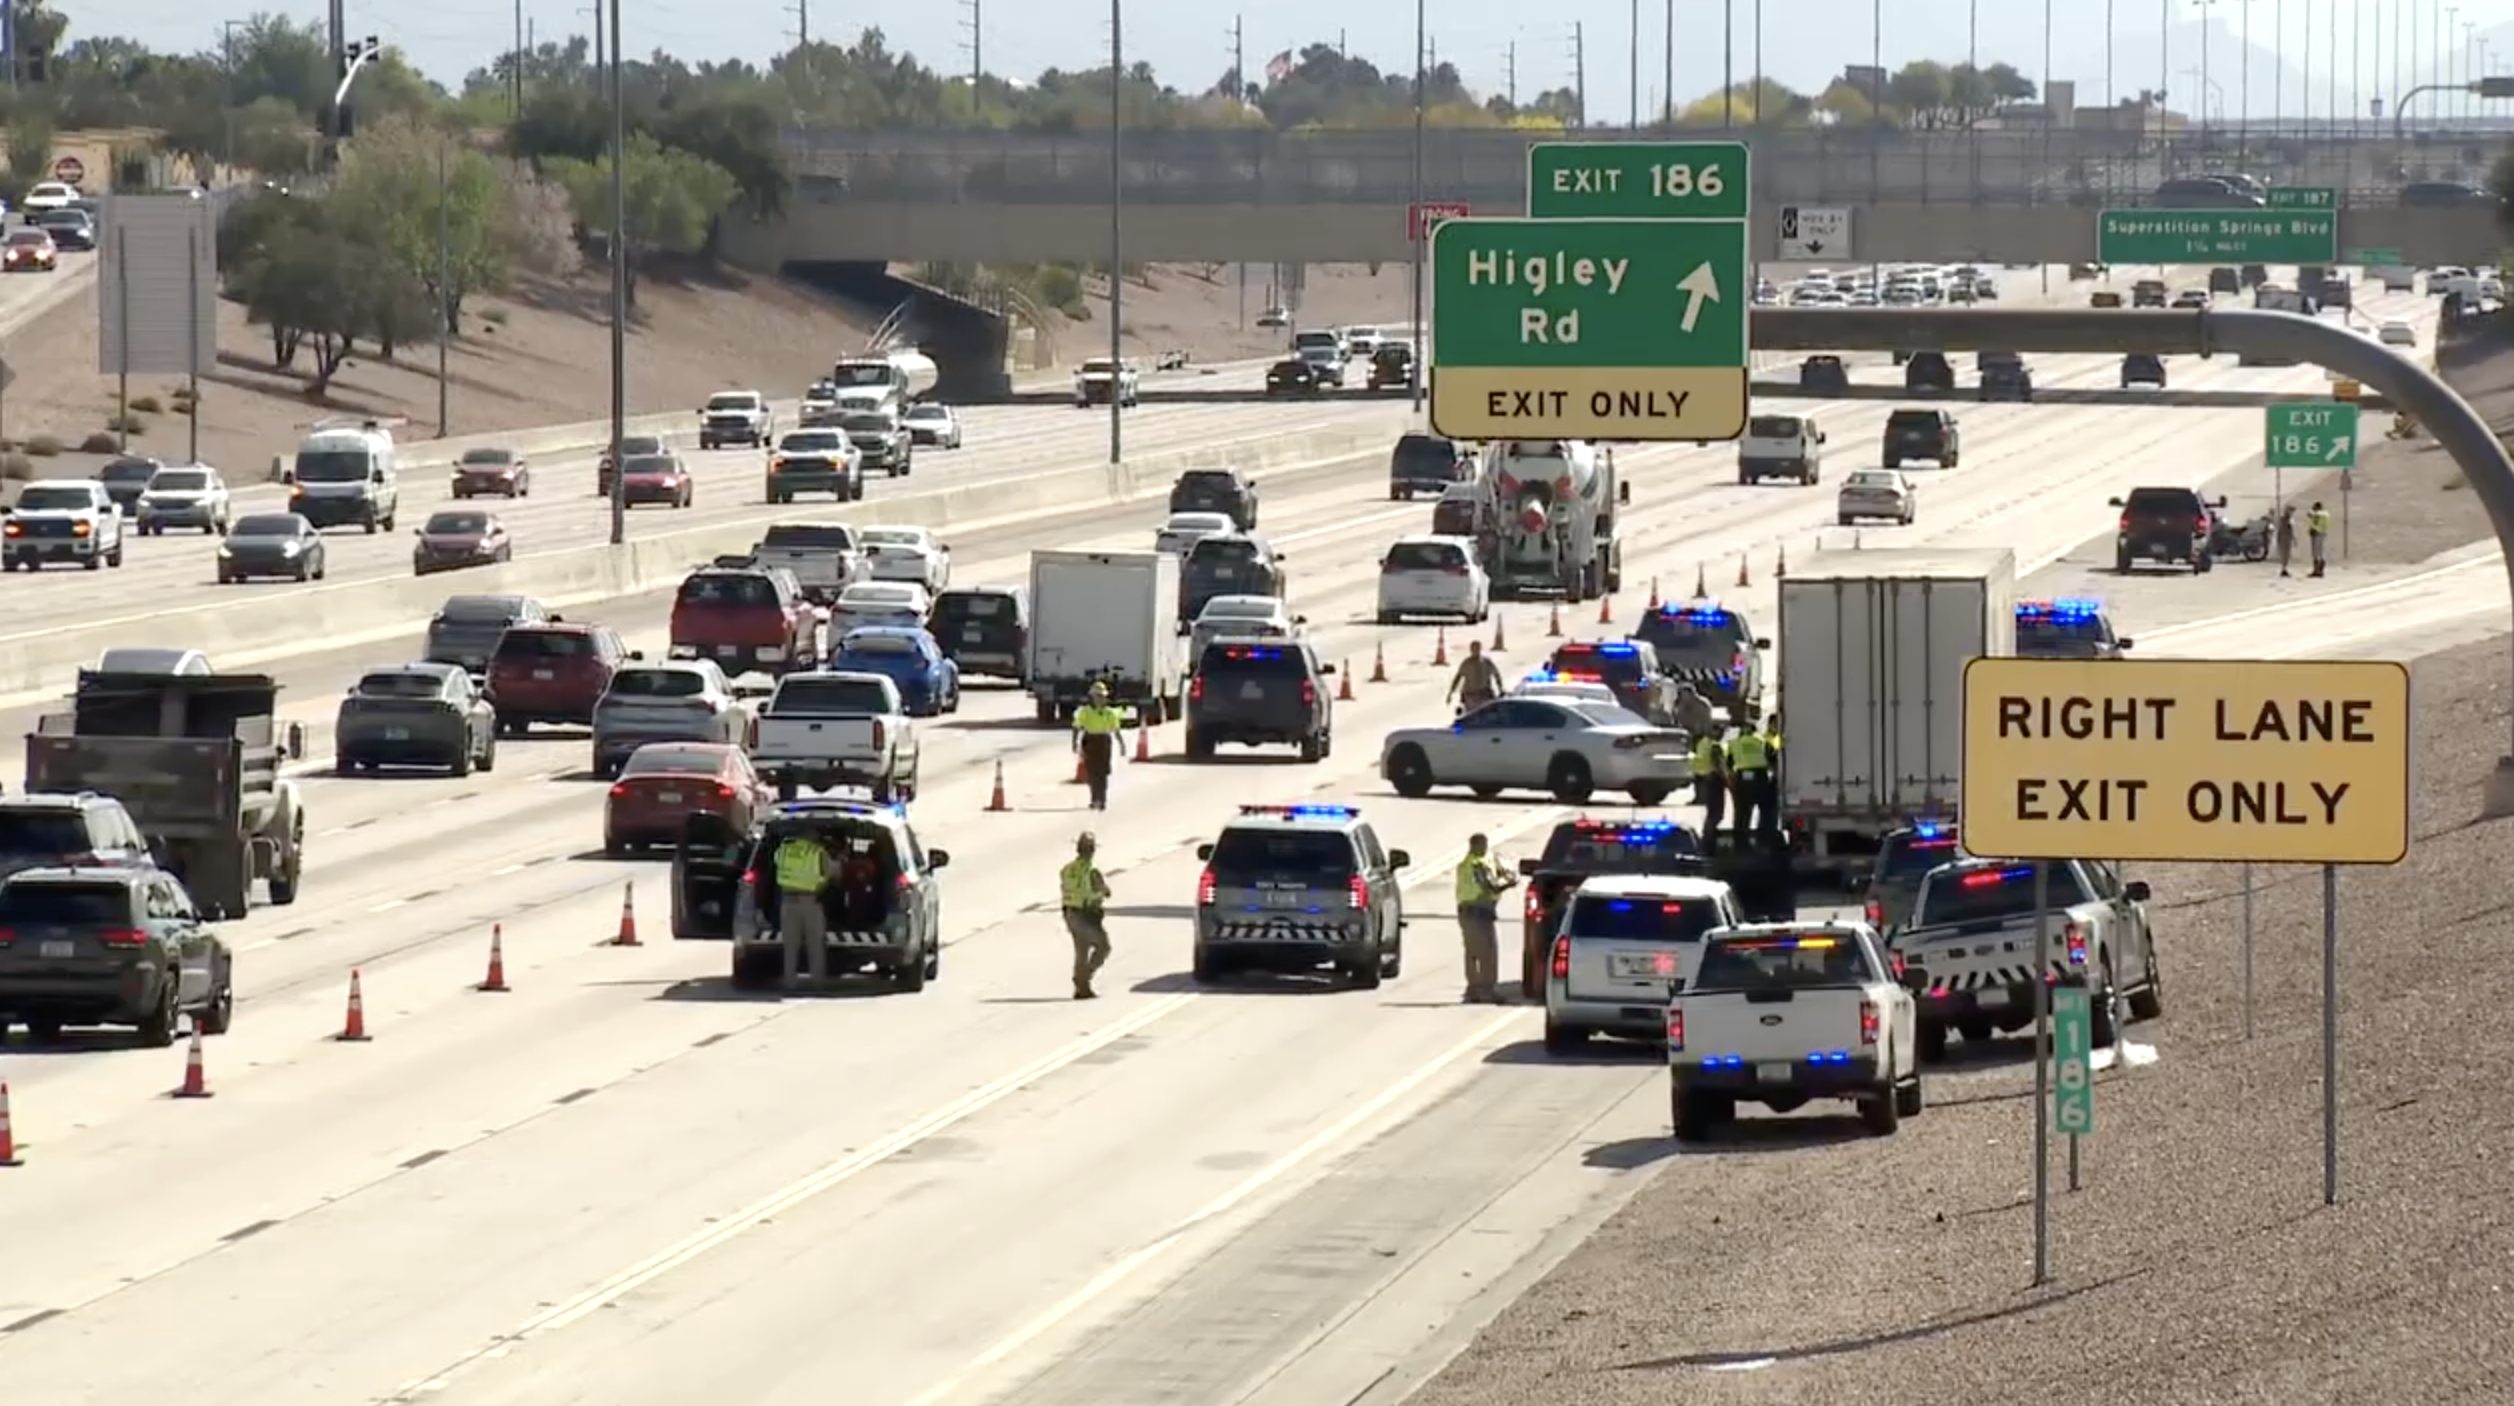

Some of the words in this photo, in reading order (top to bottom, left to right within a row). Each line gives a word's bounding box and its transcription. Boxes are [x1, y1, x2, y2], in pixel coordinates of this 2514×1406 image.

[1553, 169, 1622, 193] EXIT
[1650, 164, 1724, 198] 186
[2303, 191, 2329, 205] 187
[2107, 220, 2210, 235] Superstition
[2219, 219, 2282, 236] Springs
[2291, 220, 2328, 234] Blvd
[1469, 250, 1629, 296] Higley
[1521, 309, 1579, 343] Rd
[1487, 391, 1568, 418] EXIT
[1591, 390, 1690, 418] ONLY
[2289, 411, 2331, 426] EXIT
[2272, 435, 2319, 455] 186
[1999, 697, 2175, 739] RIGHT
[2215, 699, 2375, 743] LANE
[2017, 779, 2147, 821] EXIT
[2187, 781, 2351, 824] ONLY
[2060, 1020, 2086, 1127] 186
